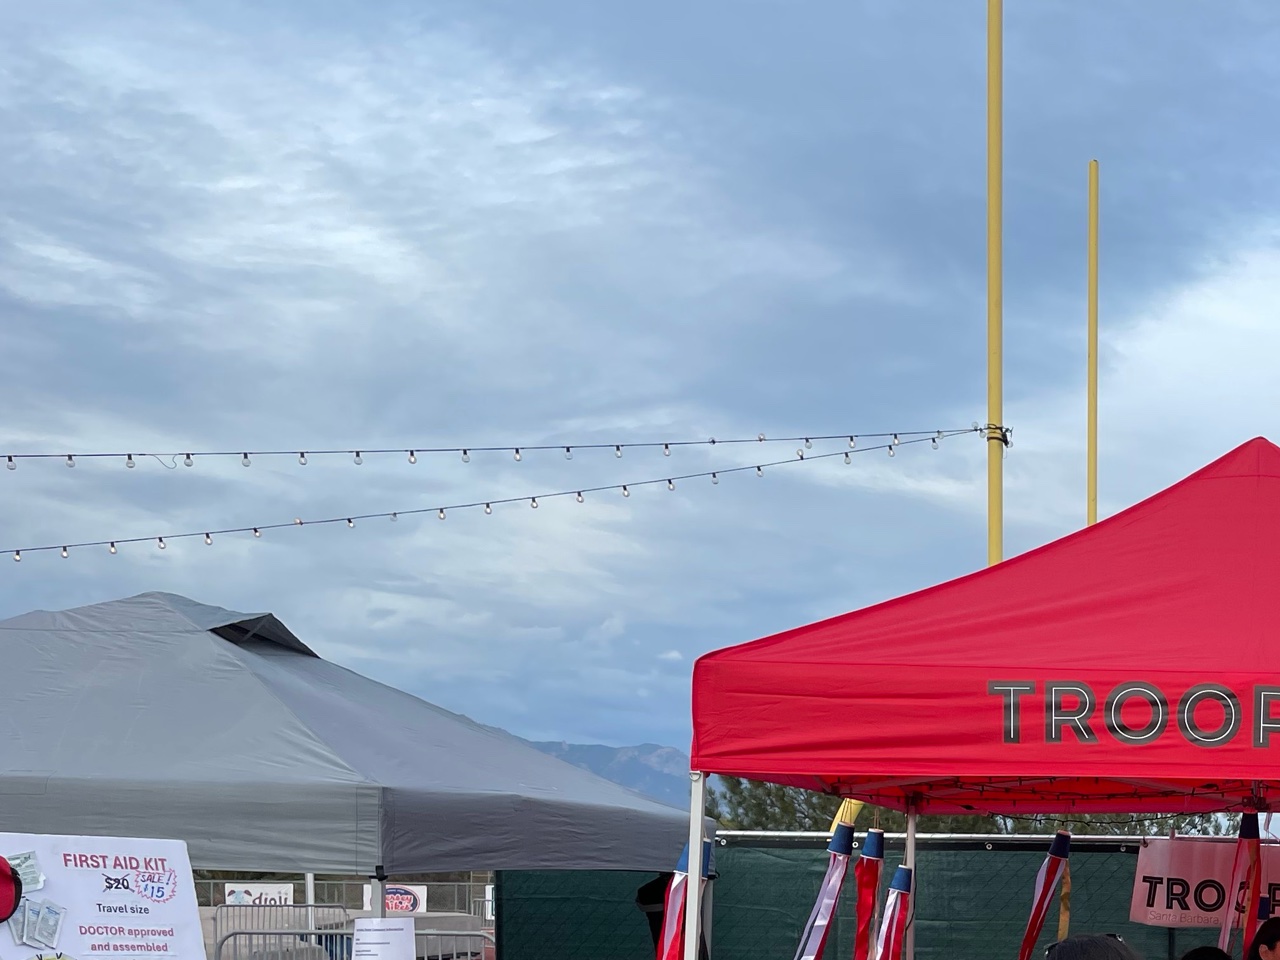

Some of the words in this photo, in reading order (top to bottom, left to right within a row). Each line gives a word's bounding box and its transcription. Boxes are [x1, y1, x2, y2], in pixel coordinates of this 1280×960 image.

[63, 853, 108, 869] FIRST
[113, 855, 140, 870] AID
[144, 857, 167, 872] KIT
[104, 877, 130, 890] $20
[143, 883, 165, 898] $15
[96, 903, 128, 913] Travel
[130, 905, 149, 914] size
[1149, 910, 1177, 922] Santa
[79, 925, 125, 936] DOCTOR
[127, 928, 174, 938] approved
[91, 942, 110, 951] and
[113, 943, 168, 952] assembled
